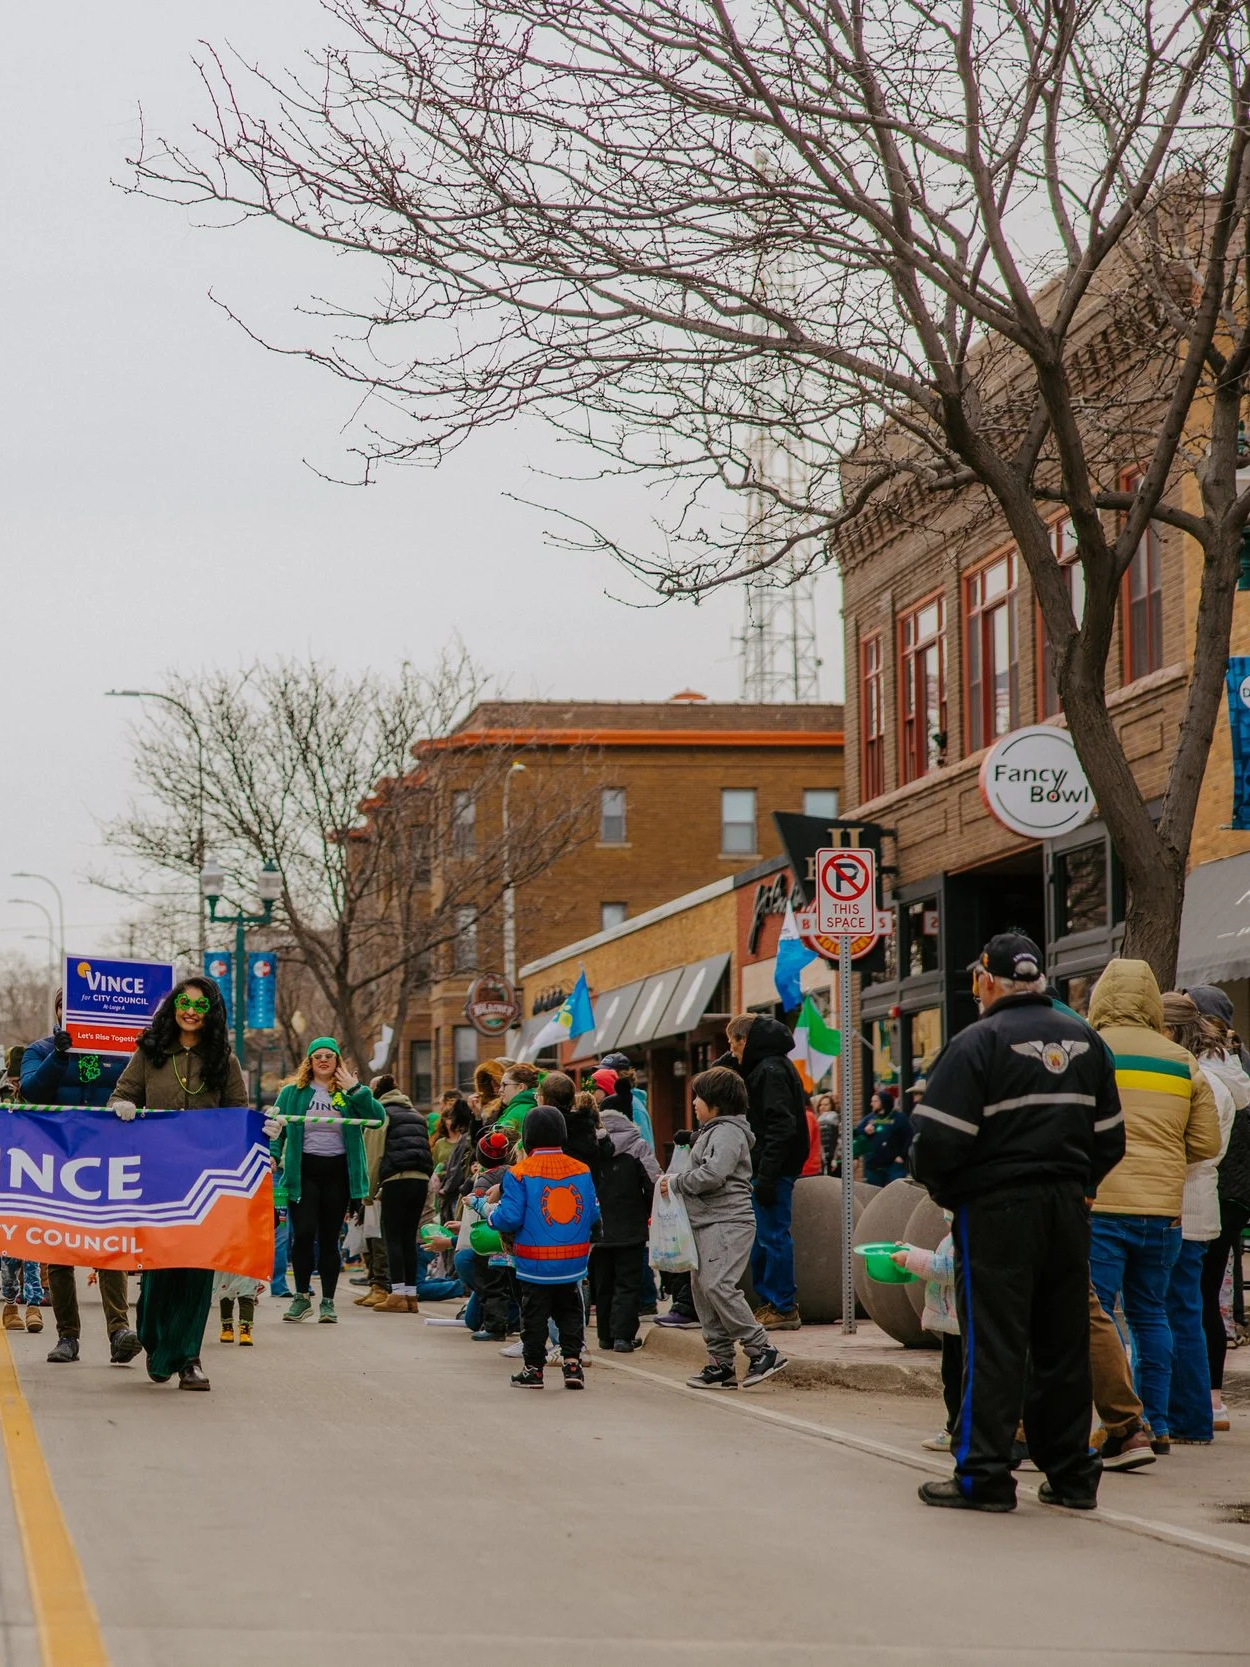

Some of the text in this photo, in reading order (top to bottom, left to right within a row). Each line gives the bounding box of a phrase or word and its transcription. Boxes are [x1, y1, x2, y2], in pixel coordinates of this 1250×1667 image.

[994, 764, 1064, 790] Fancy
[1030, 785, 1089, 803] Bowl
[832, 903, 860, 915] THIS
[826, 917, 866, 928] SPACE
[85, 969, 145, 994] VINCE
[92, 994, 112, 1002] CITY
[112, 995, 149, 1006] COUNCIL
[77, 1032, 94, 1040] Let's
[95, 1033, 110, 1041] Rise
[25, 1226, 144, 1254] COUNCIL
